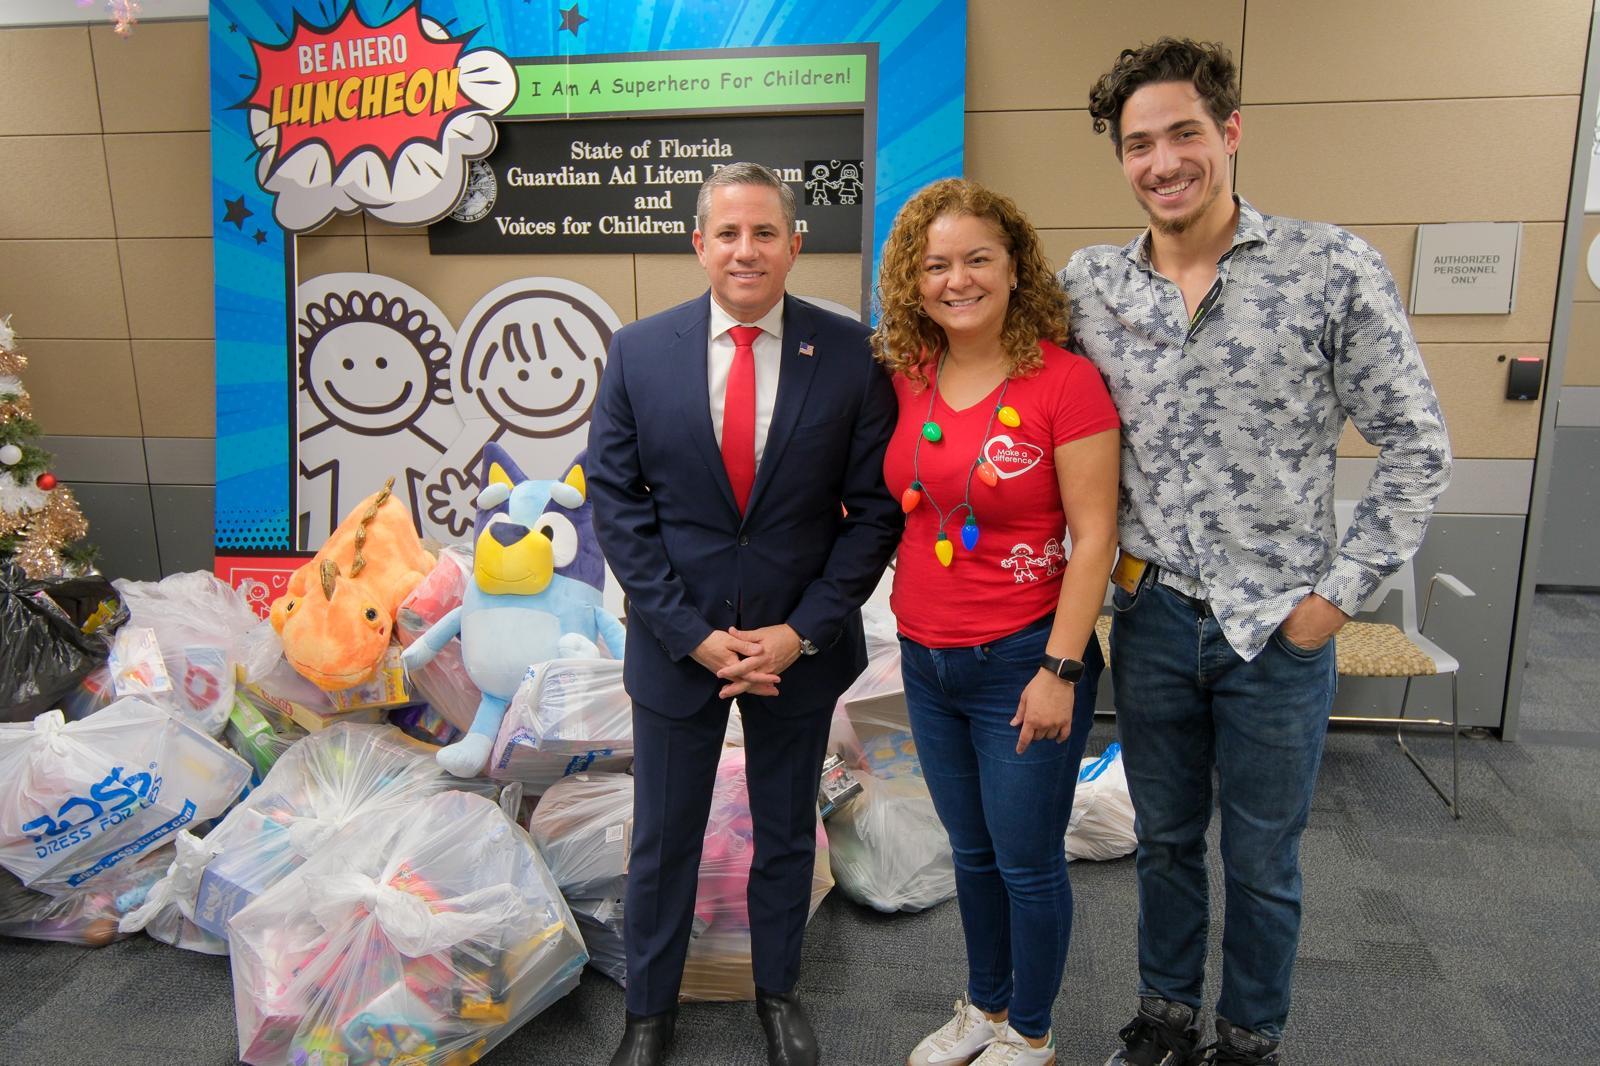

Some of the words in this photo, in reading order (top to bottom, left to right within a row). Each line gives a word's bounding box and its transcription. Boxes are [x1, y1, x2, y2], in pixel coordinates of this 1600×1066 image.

[299, 45, 326, 74] BE
[332, 42, 349, 71] A
[349, 34, 408, 69] HERO
[531, 81, 541, 97] I
[552, 81, 579, 96] Am
[589, 79, 601, 95] A
[612, 74, 710, 98] Superhero
[720, 72, 752, 90] For
[763, 67, 851, 88] Children!
[270, 67, 461, 127] LUNCHEON
[571, 140, 623, 160] State
[630, 139, 652, 159] of
[659, 137, 733, 158] Florida
[507, 165, 601, 187] Guardian
[608, 165, 637, 185] Ad
[643, 164, 704, 185] Litem
[634, 190, 673, 209] and
[495, 216, 556, 236] Voices
[562, 215, 593, 235] for
[599, 215, 686, 234] Children
[1433, 255, 1500, 264] AUTHORIZED
[1433, 265, 1497, 274] PERSONNEL
[1451, 276, 1477, 284] ONLY
[992, 455, 1033, 464] difference
[997, 449, 1020, 457] Make
[35, 825, 92, 859] DRESS
[100, 807, 135, 832] FOR
